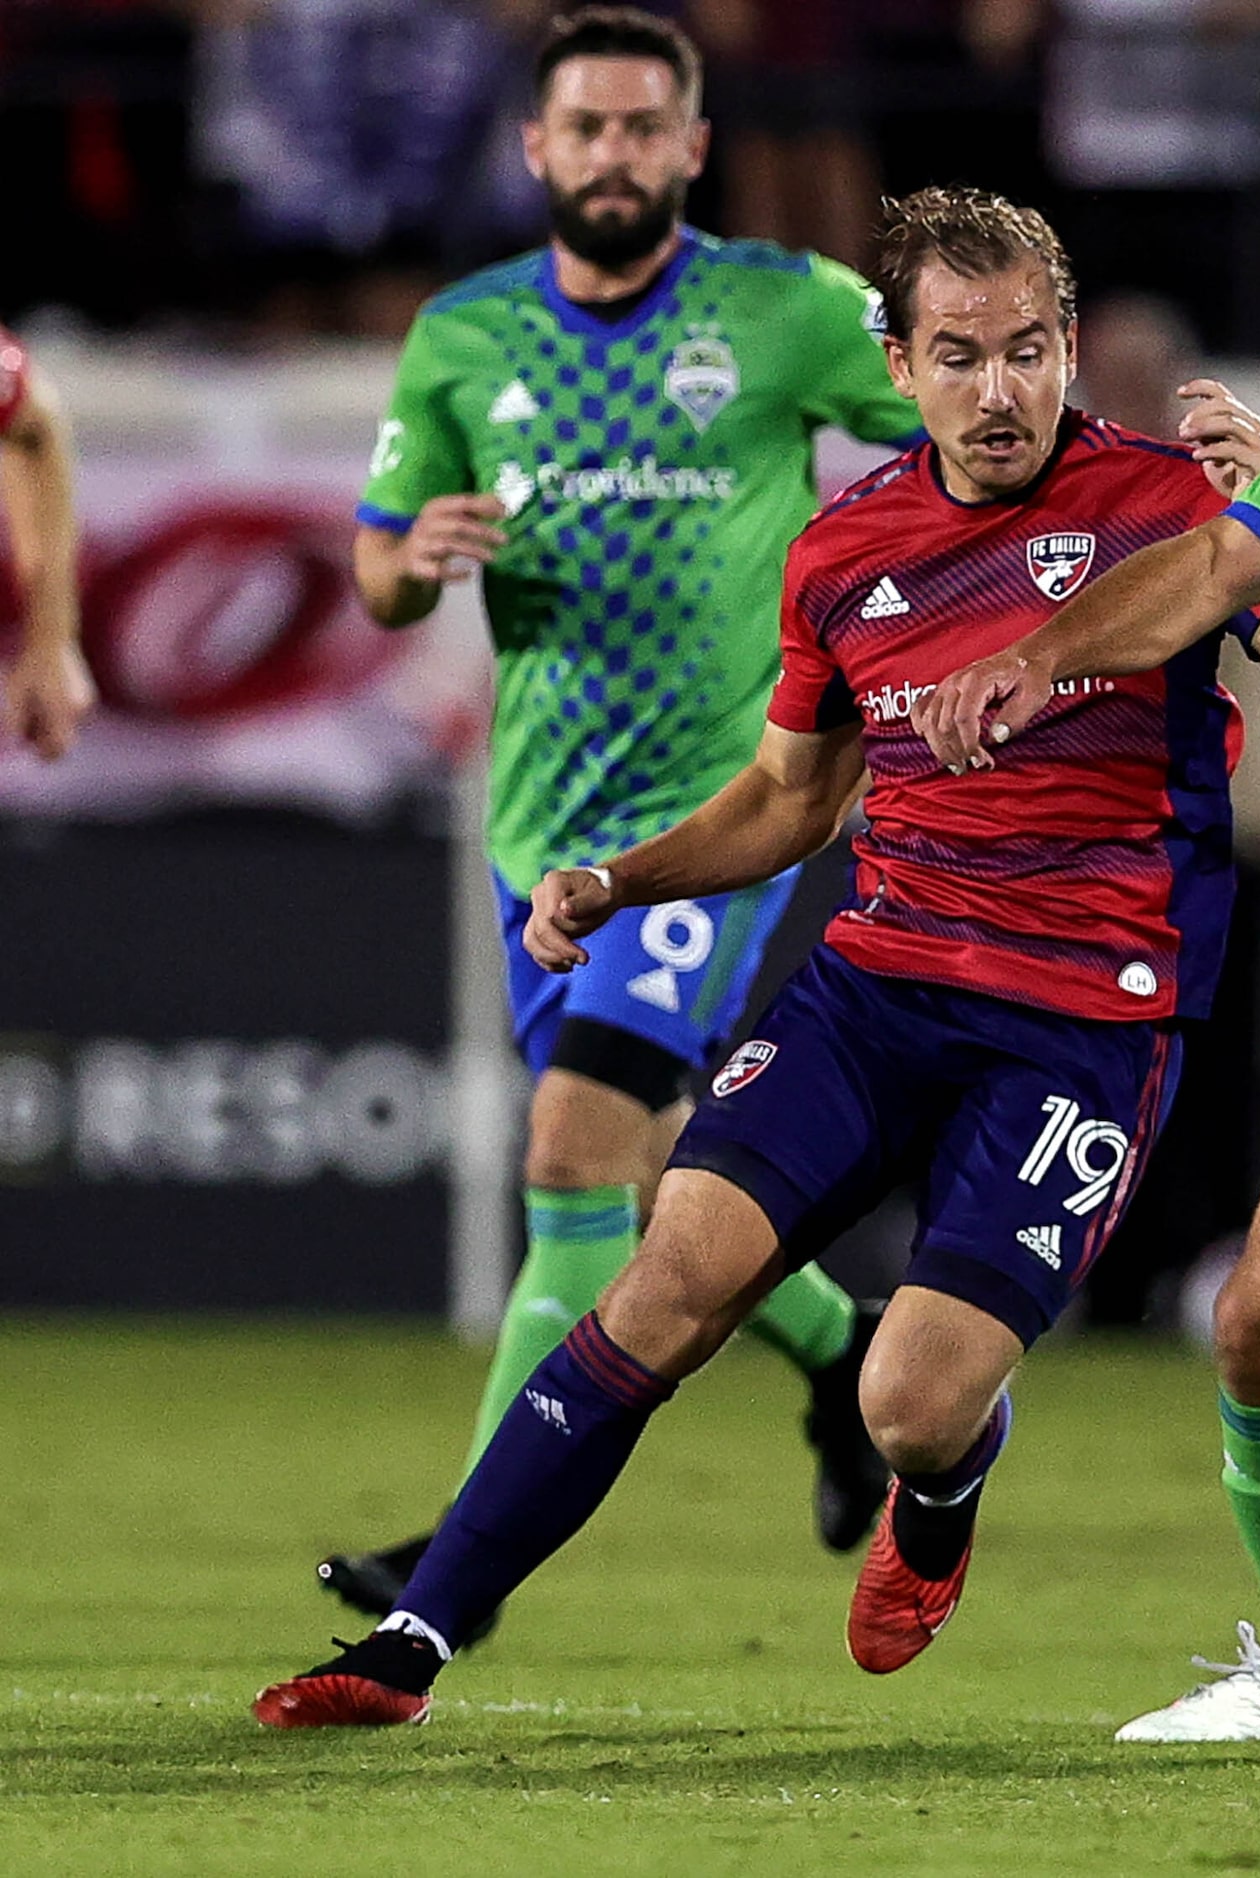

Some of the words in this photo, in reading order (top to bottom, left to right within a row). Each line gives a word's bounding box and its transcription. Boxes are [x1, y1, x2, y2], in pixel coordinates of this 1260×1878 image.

[1032, 540, 1047, 558] FC
[1049, 537, 1090, 554] DALLAS
[860, 600, 911, 620] adidas
[1127, 974, 1147, 989] LH
[1017, 1094, 1129, 1217] 19
[1016, 1229, 1062, 1271] adidas
